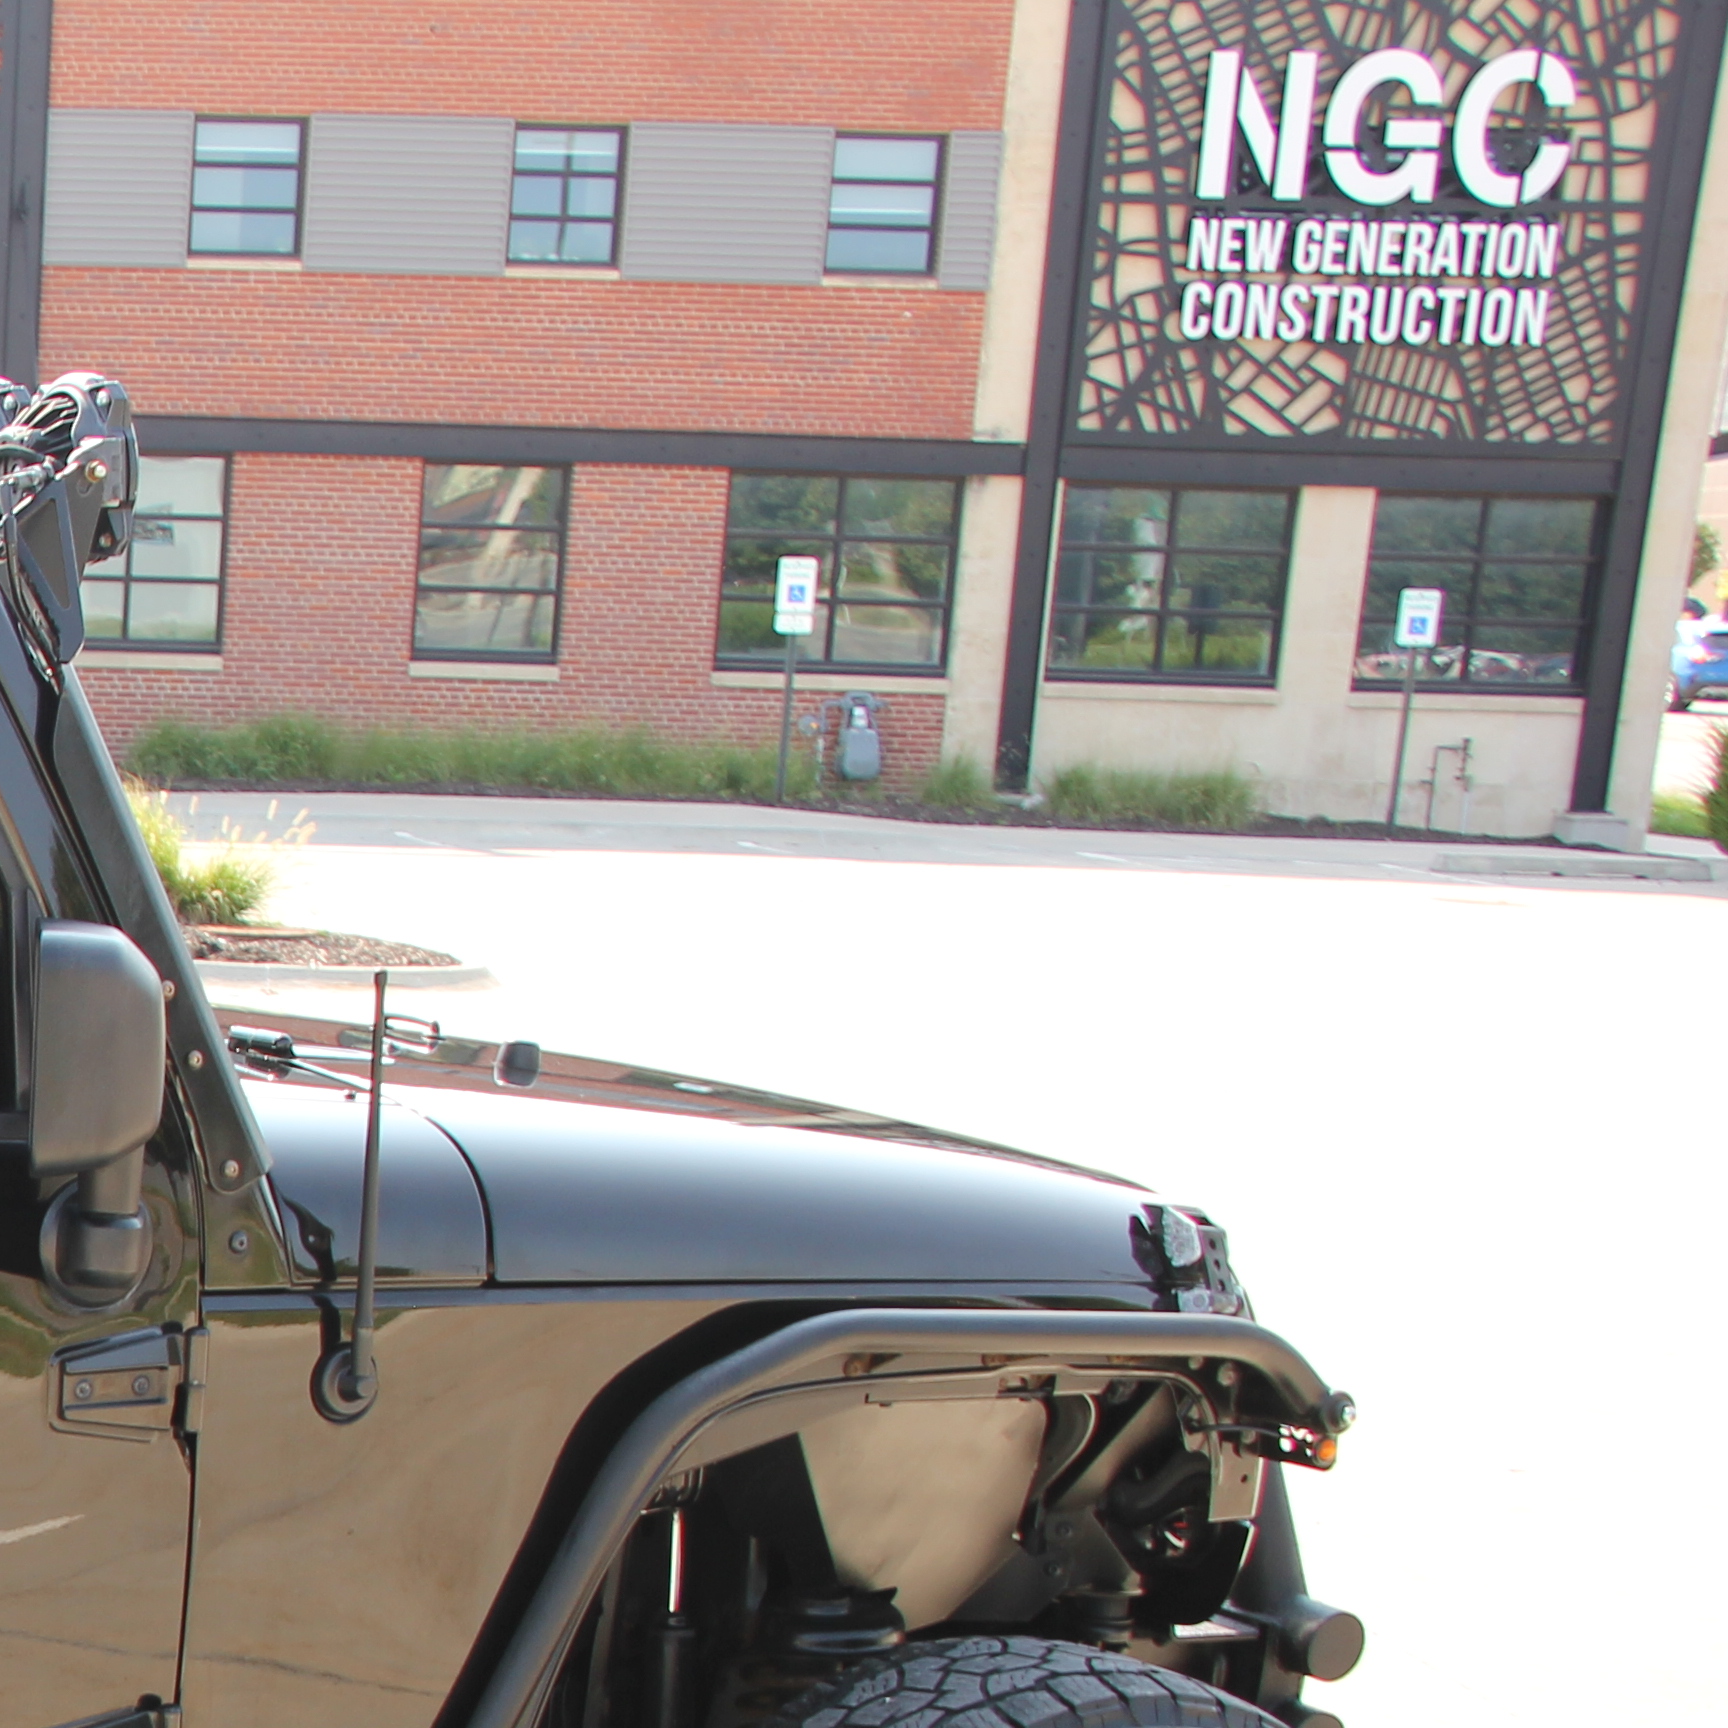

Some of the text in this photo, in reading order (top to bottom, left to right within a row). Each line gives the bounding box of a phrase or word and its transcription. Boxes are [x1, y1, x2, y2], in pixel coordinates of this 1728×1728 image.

[1195, 48, 1577, 207] NGC
[1187, 217, 1560, 279] NEW GENERATION
[1180, 282, 1549, 347] CONSTRUCTION
